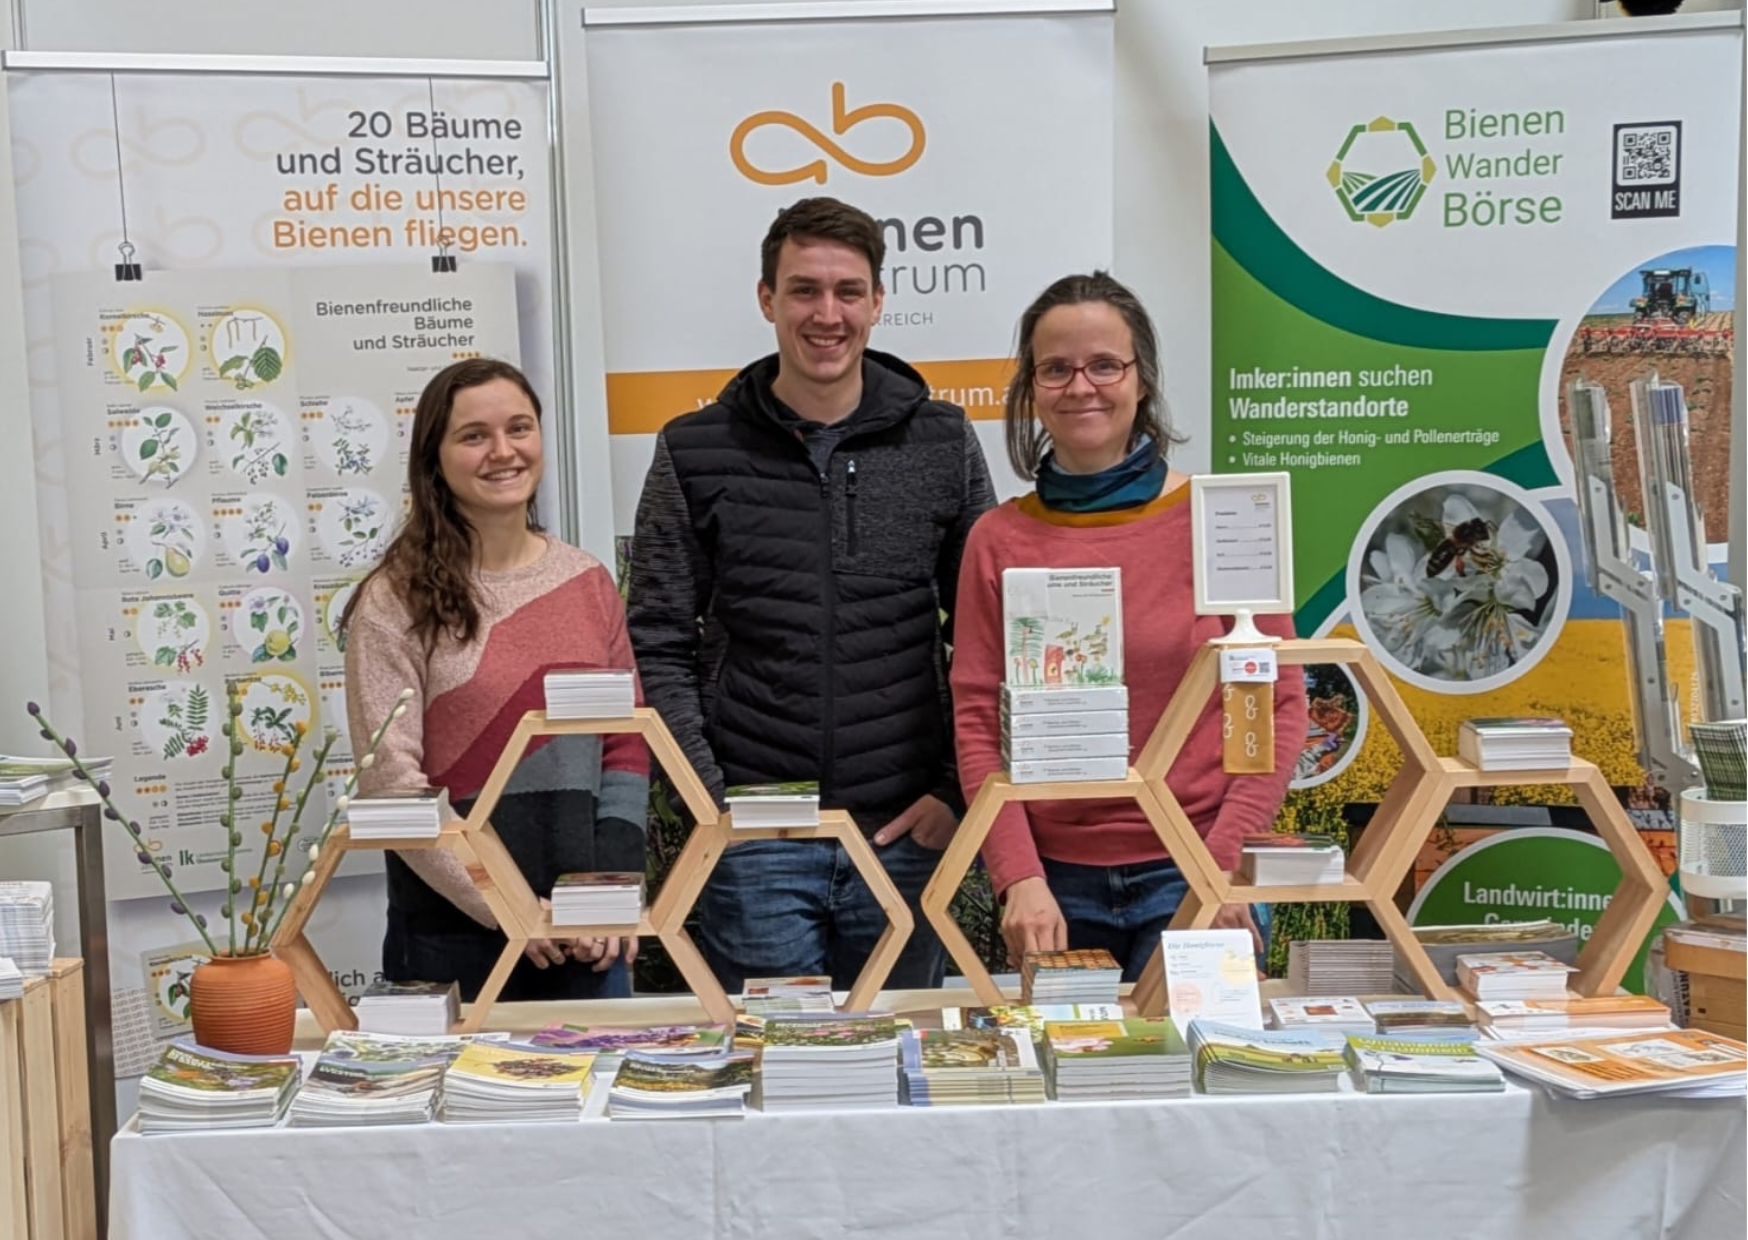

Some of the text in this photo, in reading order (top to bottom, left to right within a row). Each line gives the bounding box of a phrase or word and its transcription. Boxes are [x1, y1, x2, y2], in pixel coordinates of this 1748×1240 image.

[348, 111, 523, 140] 20 Bäume
[1444, 109, 1565, 140] Bienen
[276, 146, 525, 180] und Sträucher,
[1444, 149, 1563, 180] Wander
[283, 183, 527, 211] auf die unsere
[1443, 190, 1563, 228] Börse
[1615, 190, 1676, 211] SCAN ME
[273, 218, 528, 252] Bienen fliegen.
[316, 297, 473, 316] Bienenfreundliche
[414, 316, 475, 331] Bäume
[353, 333, 475, 350] und Sträucher
[1229, 363, 1433, 390] Imker:innen suchen
[1229, 395, 1409, 419] Wanderstandorte
[1243, 428, 1500, 448] Steigerung der Honig- und Pollenerträge
[1242, 451, 1361, 469] Vitale Honigbienen
[1463, 880, 1613, 911] Landwirt:inne
